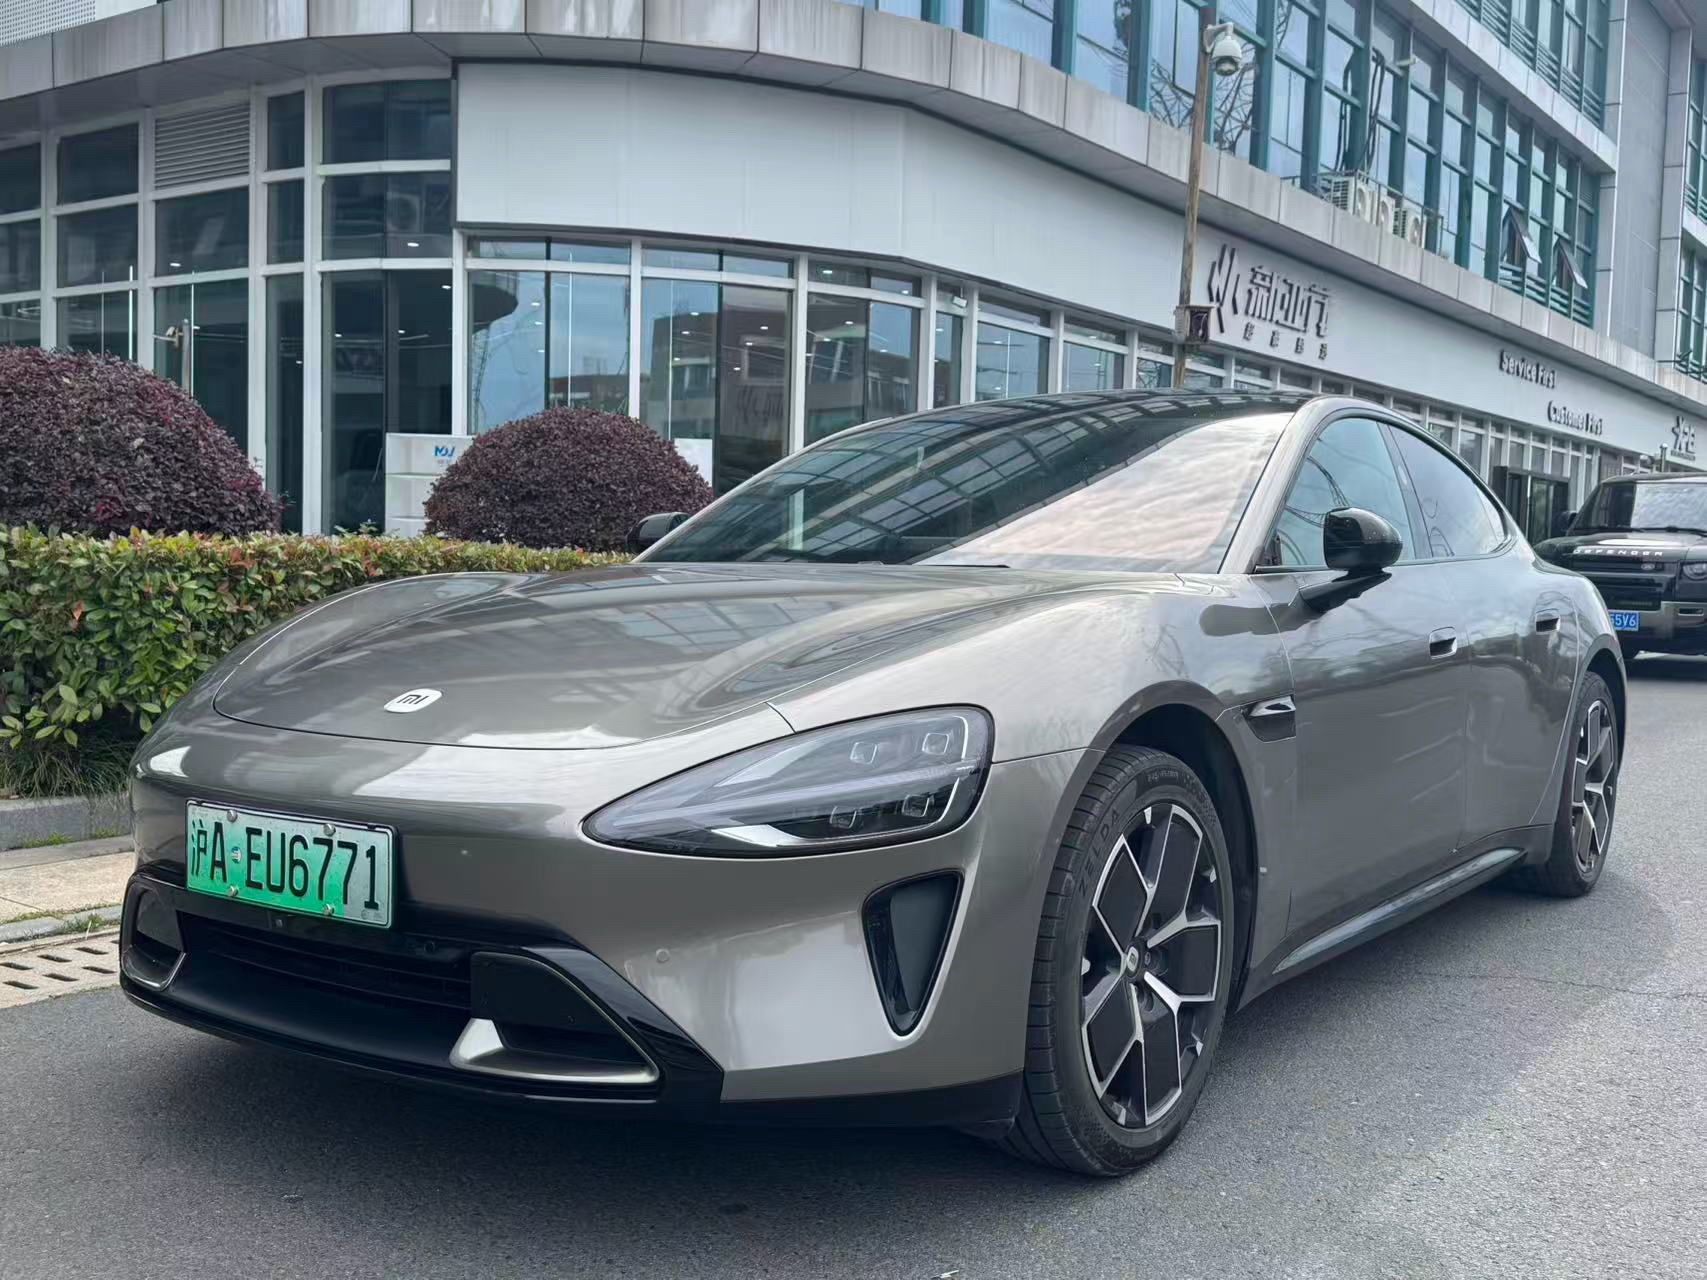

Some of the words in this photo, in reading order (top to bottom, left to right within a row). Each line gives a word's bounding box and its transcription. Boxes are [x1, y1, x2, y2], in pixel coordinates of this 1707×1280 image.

[1500, 350, 1537, 383] Service
[1536, 363, 1556, 389] First
[1548, 400, 1585, 430] Customer
[1586, 413, 1604, 436] First
